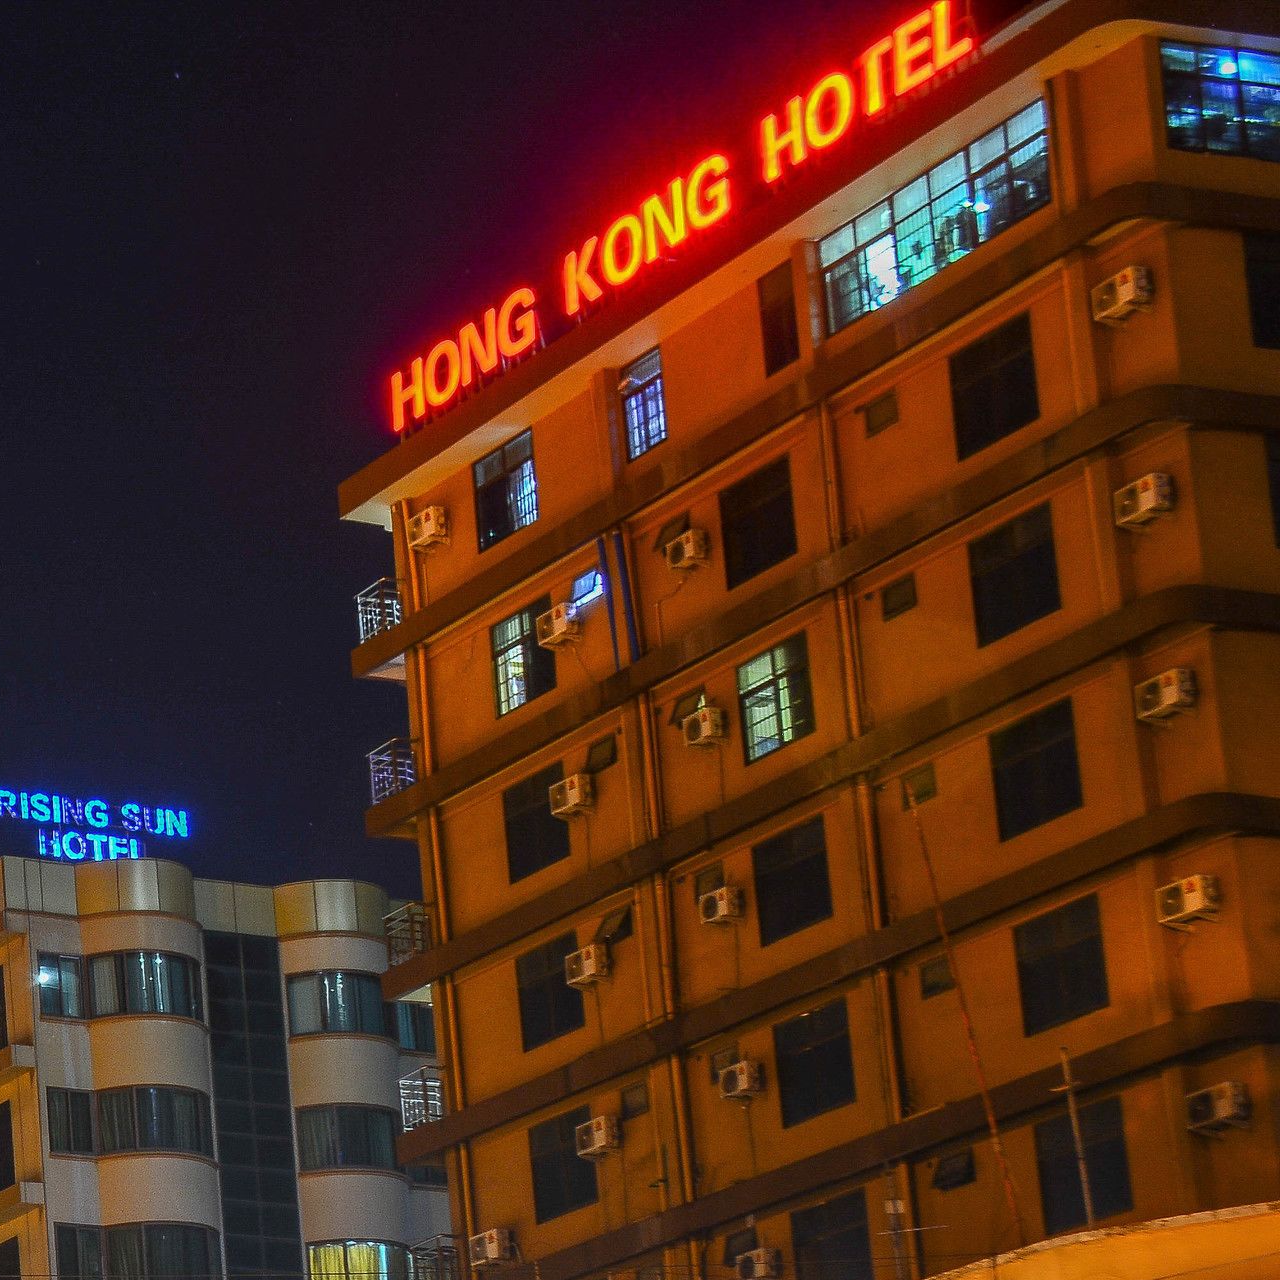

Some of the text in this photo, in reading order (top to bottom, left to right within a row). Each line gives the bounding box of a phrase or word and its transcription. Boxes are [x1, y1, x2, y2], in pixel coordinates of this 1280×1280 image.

[390, 1, 973, 432] HONG KONG HOTEL
[122, 803, 189, 837] SUN
